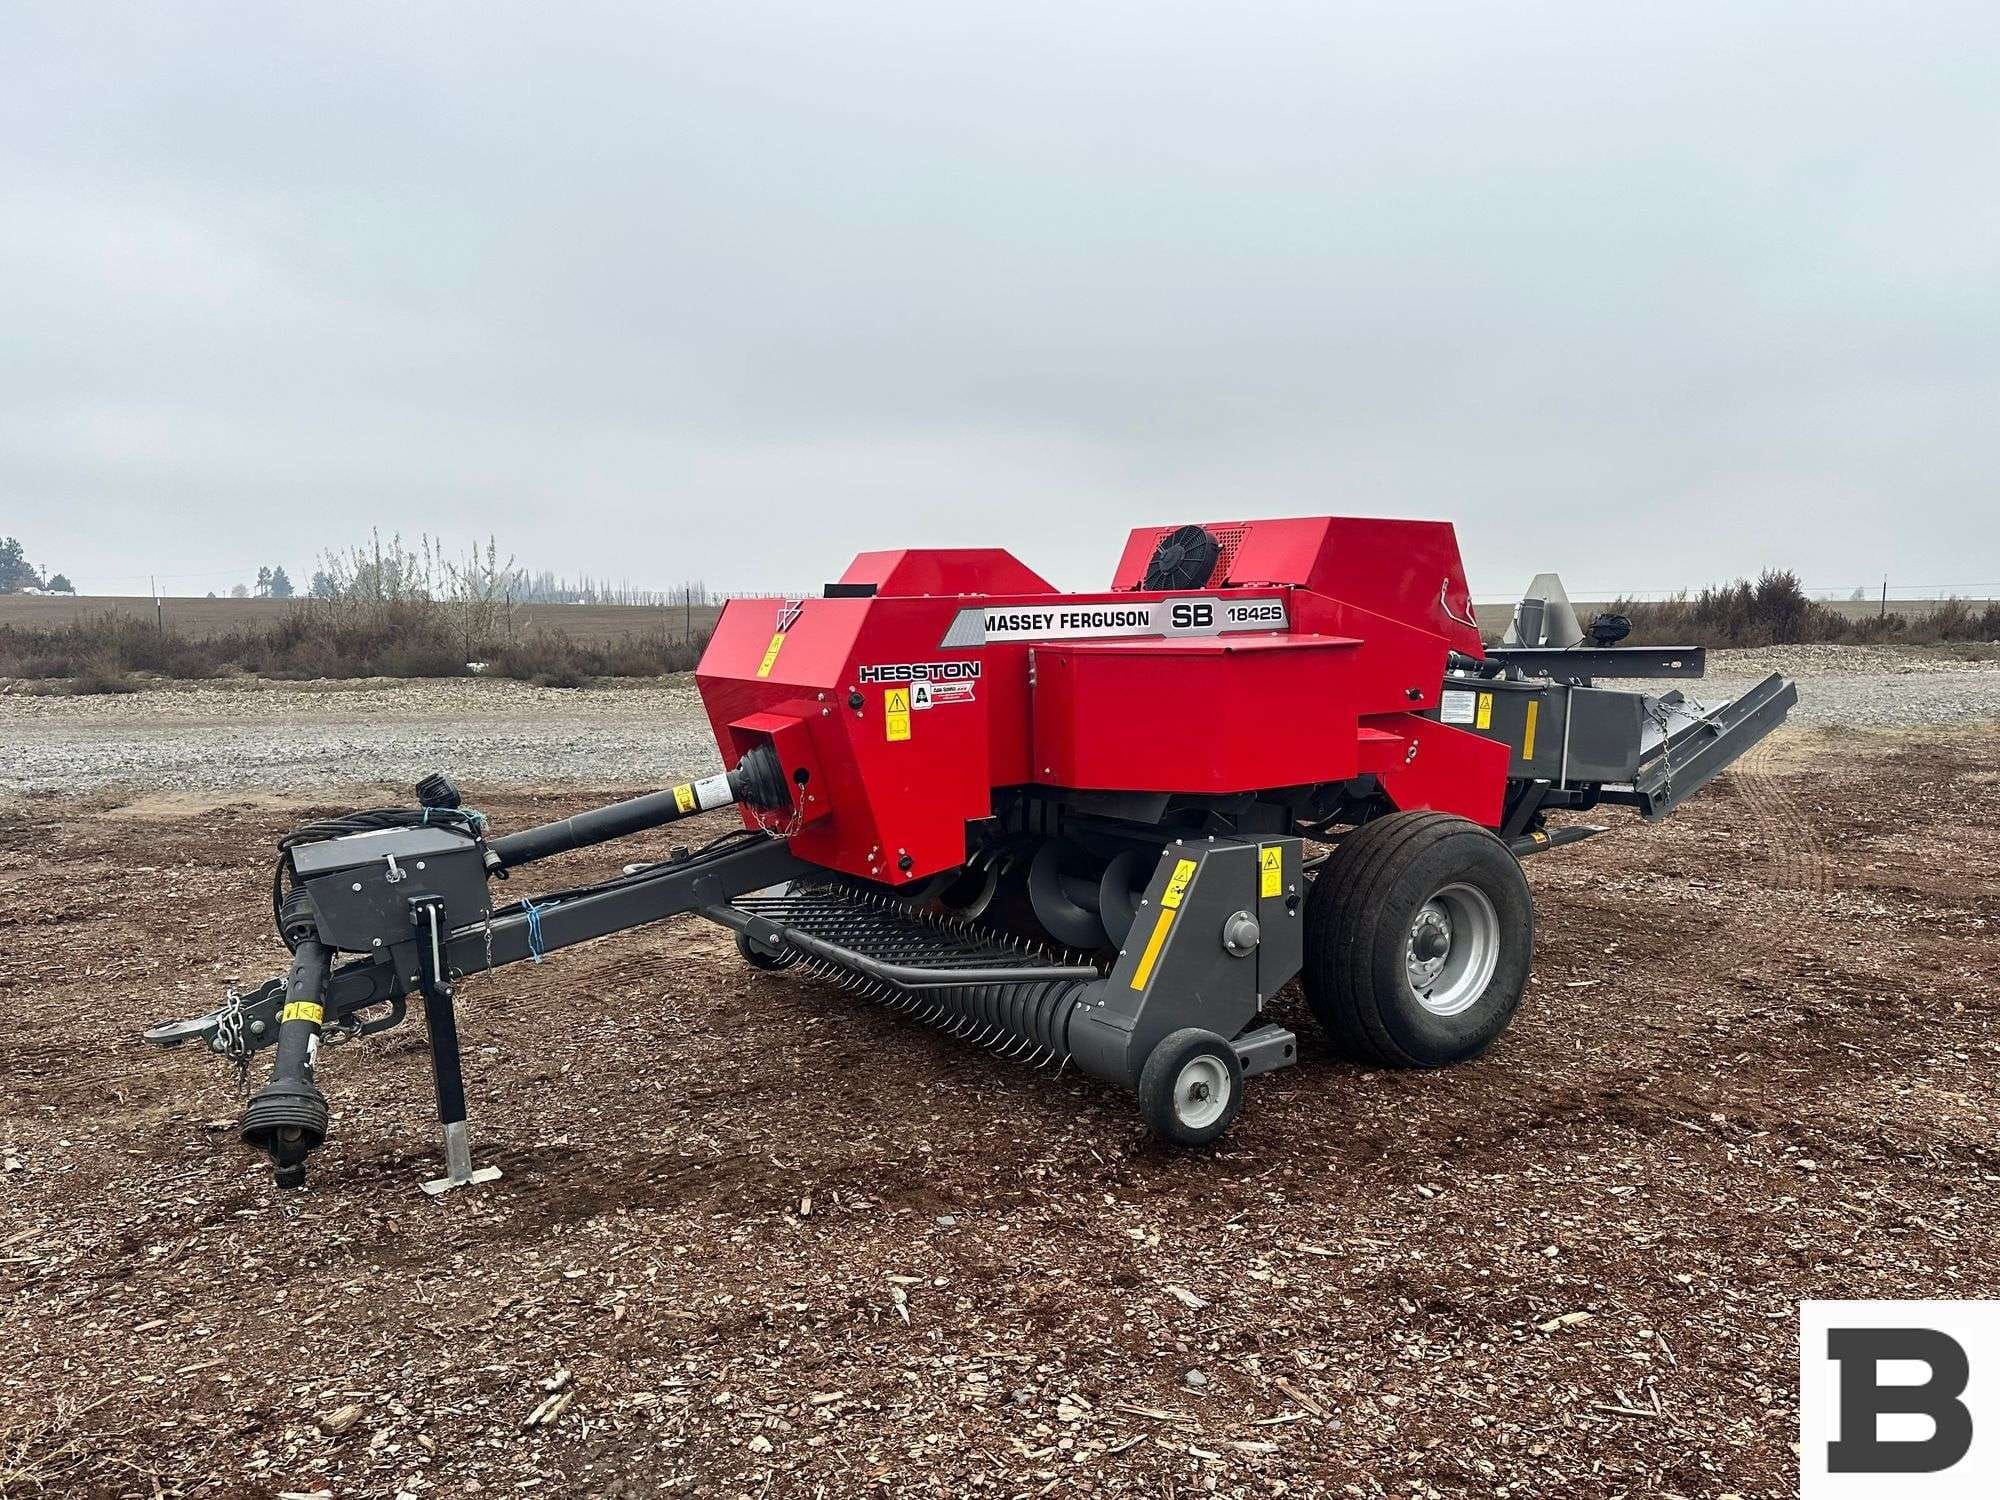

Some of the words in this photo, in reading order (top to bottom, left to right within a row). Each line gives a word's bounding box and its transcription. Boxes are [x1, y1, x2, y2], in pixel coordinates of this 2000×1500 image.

[984, 613, 1054, 632] MASSEY
[1060, 611, 1149, 629] FERGUSON
[1171, 603, 1214, 628] SB
[1226, 605, 1283, 622] 1842S
[860, 662, 980, 682] HESSTON
